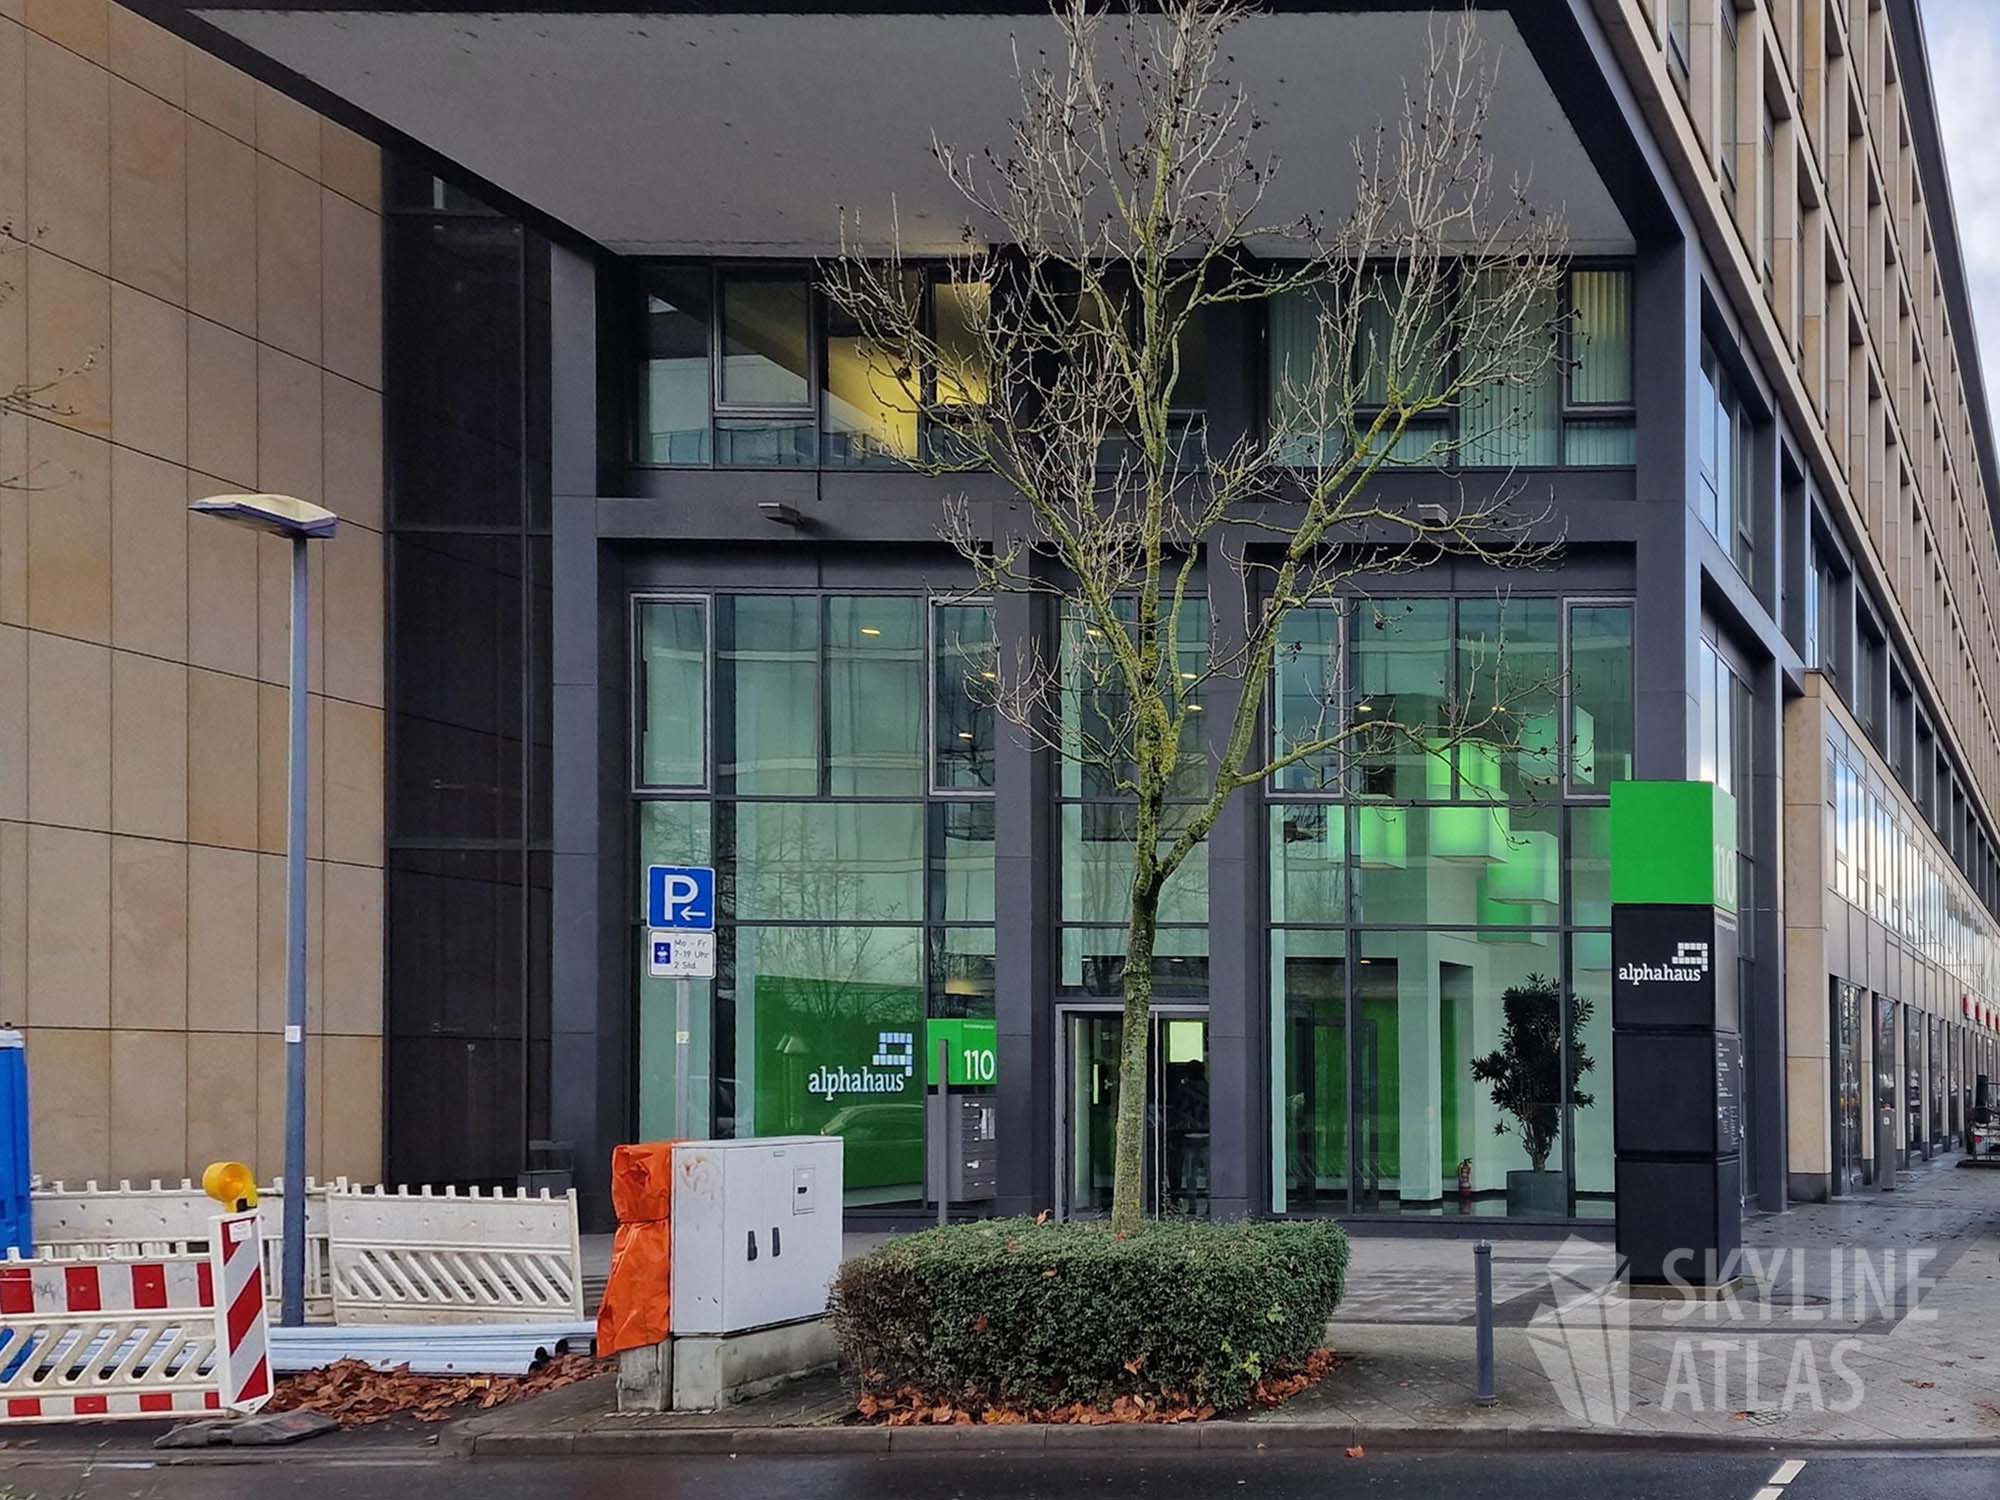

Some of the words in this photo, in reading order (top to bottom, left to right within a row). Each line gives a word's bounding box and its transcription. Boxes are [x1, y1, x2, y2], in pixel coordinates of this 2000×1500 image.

[664, 874, 699, 920] P
[1618, 963, 1701, 985] alphahaus
[963, 1049, 996, 1080] 110
[808, 1065, 905, 1101] alphahaus
